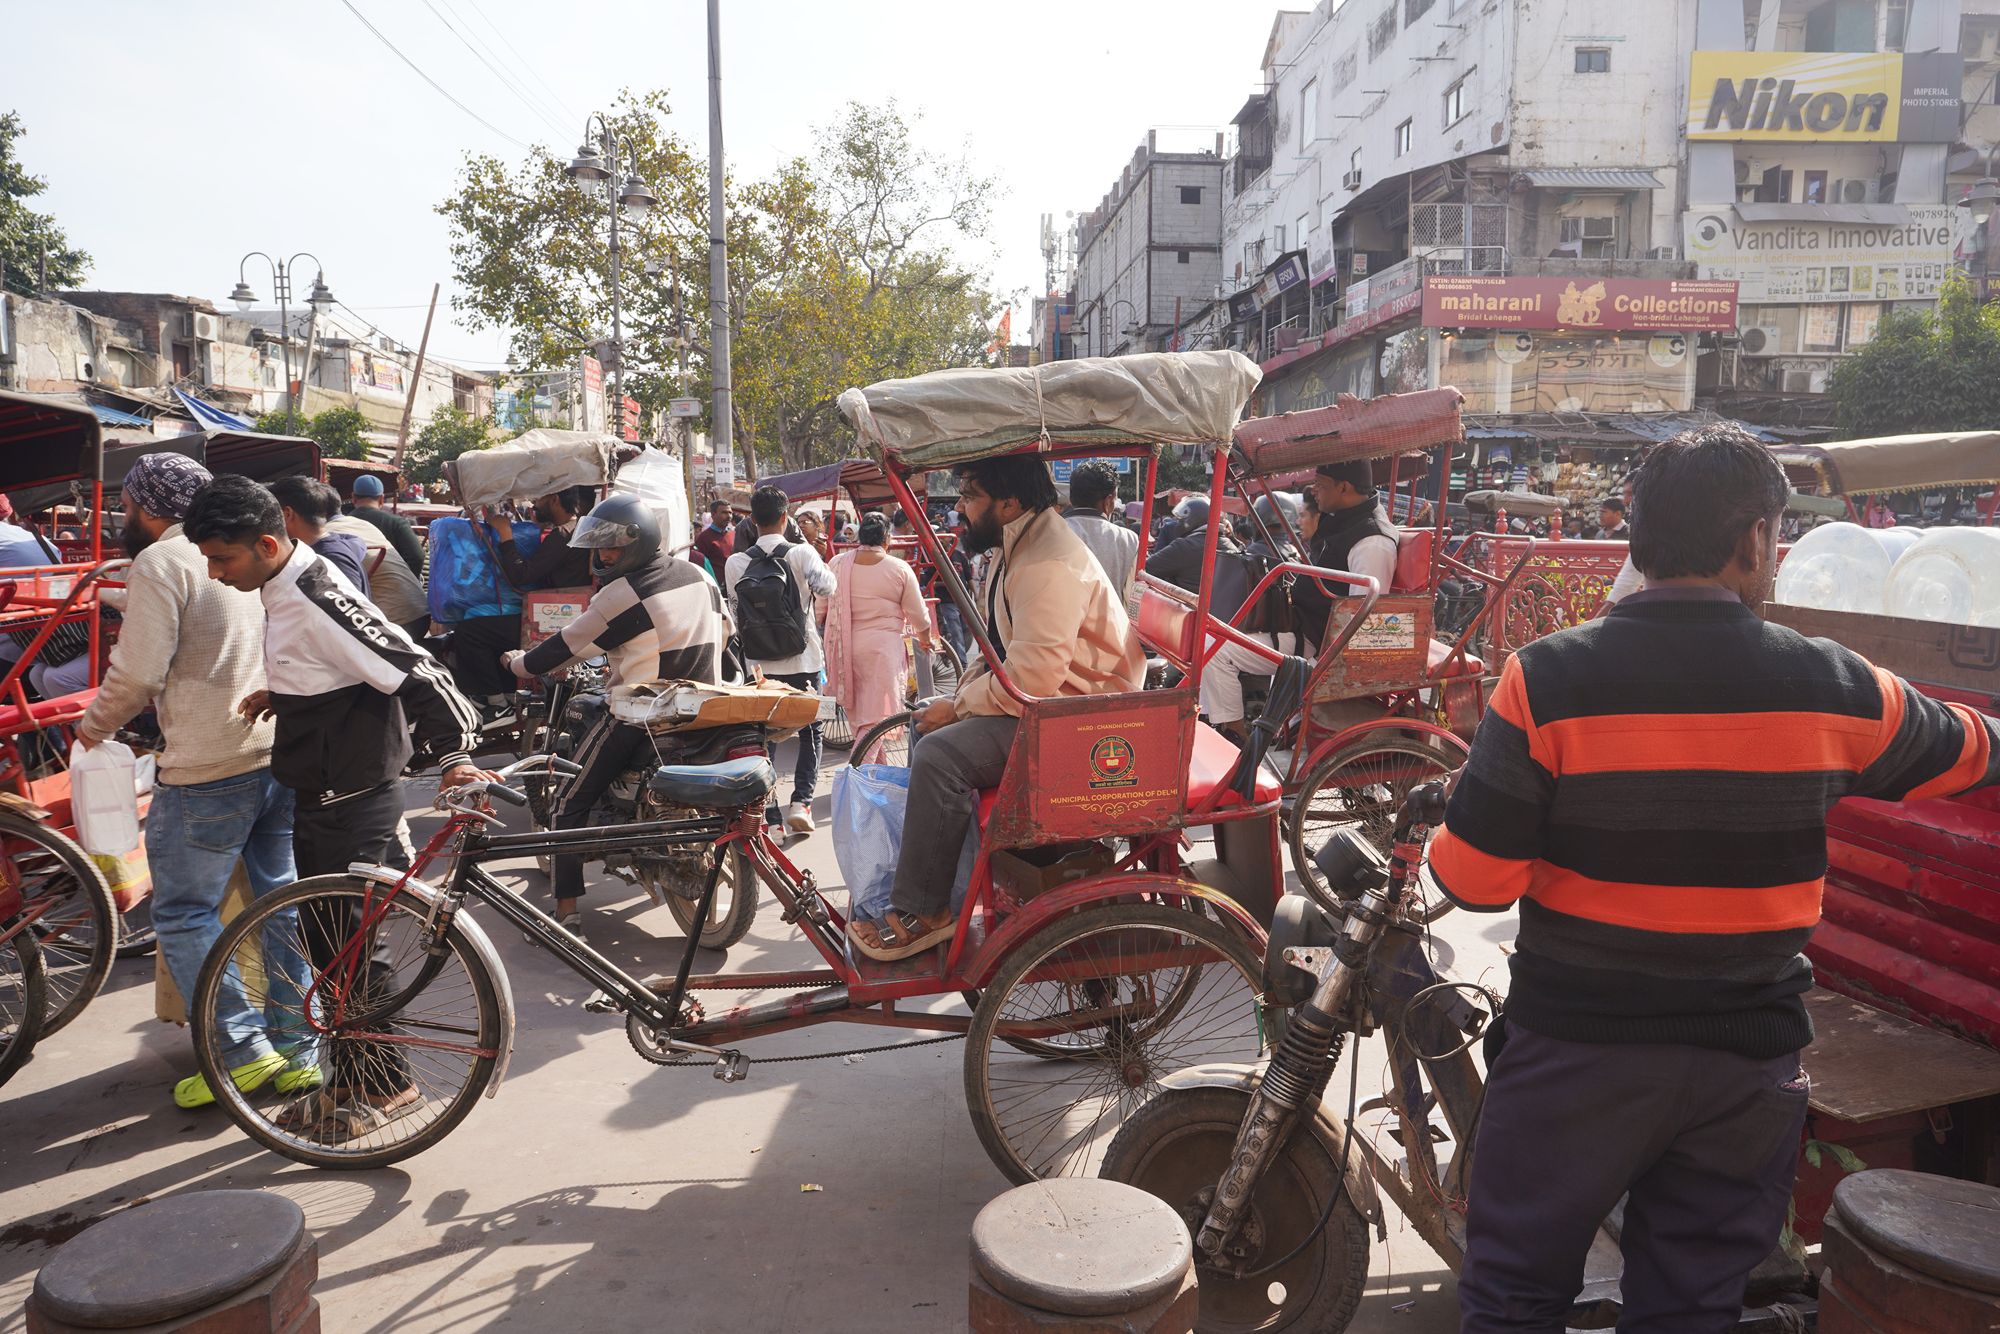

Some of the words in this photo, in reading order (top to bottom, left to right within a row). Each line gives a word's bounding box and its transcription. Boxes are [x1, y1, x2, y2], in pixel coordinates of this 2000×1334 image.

[1913, 87, 1949, 96] IMPERIAL
[1704, 77, 1888, 133] Nikon
[1902, 98, 1929, 106] PHOTO
[1930, 98, 1959, 106] STORES
[1732, 226, 1819, 250] Vandita
[1828, 223, 1950, 249] Innovative
[1829, 251, 1843, 262] and
[1440, 293, 1541, 312] maharani
[1614, 294, 1731, 314] Collections
[1458, 313, 1482, 321] Bridal
[1483, 314, 1522, 322] Lehengas
[1632, 314, 1672, 322] Non-bridal
[1673, 315, 1710, 323] Lehengas
[324, 590, 389, 647] adidas
[1077, 724, 1094, 732] WARD
[1050, 795, 1090, 804] MUNICIPAL
[1091, 791, 1144, 801] CORPORATION
[1156, 788, 1179, 797] DELHI
